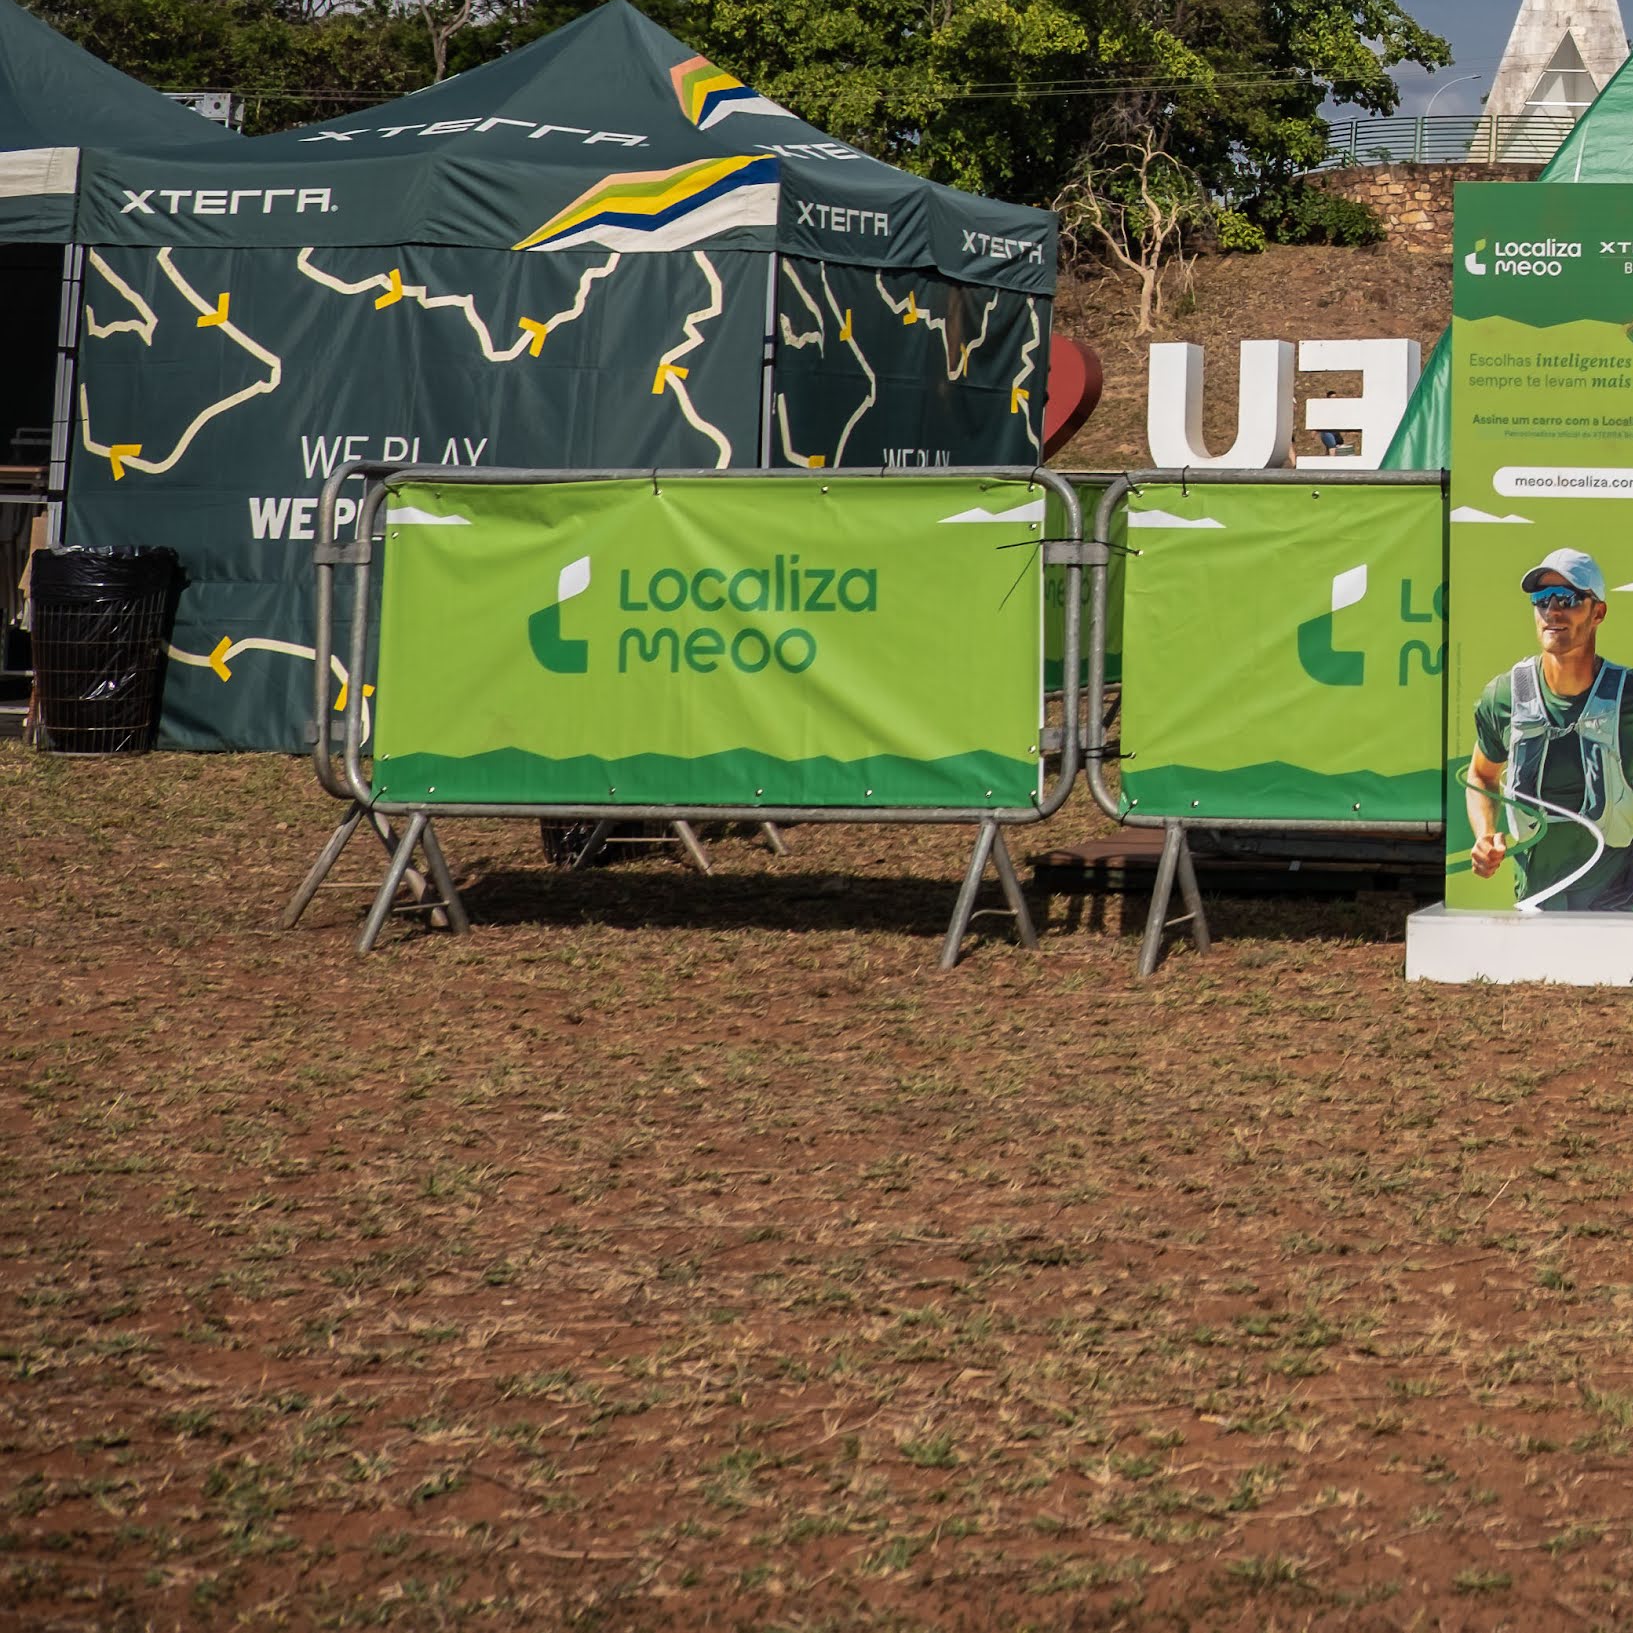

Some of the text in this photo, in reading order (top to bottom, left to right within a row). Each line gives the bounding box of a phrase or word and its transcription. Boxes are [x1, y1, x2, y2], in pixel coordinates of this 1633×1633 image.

[1495, 239, 1582, 257] Localiza
[1495, 260, 1562, 276] meoo
[1469, 352, 1632, 371] Escolhas inteligentes
[1468, 376, 1523, 389] sempre
[1527, 376, 1540, 388] te
[1544, 375, 1588, 388] levam
[1591, 373, 1632, 389] mais
[1472, 414, 1509, 425] Assine
[1511, 416, 1529, 426] um
[1532, 416, 1563, 426] carro
[1565, 416, 1590, 426] com
[301, 435, 369, 479] WE
[249, 497, 318, 540] WE
[619, 554, 877, 613] Localiza
[618, 627, 817, 674] meoo
